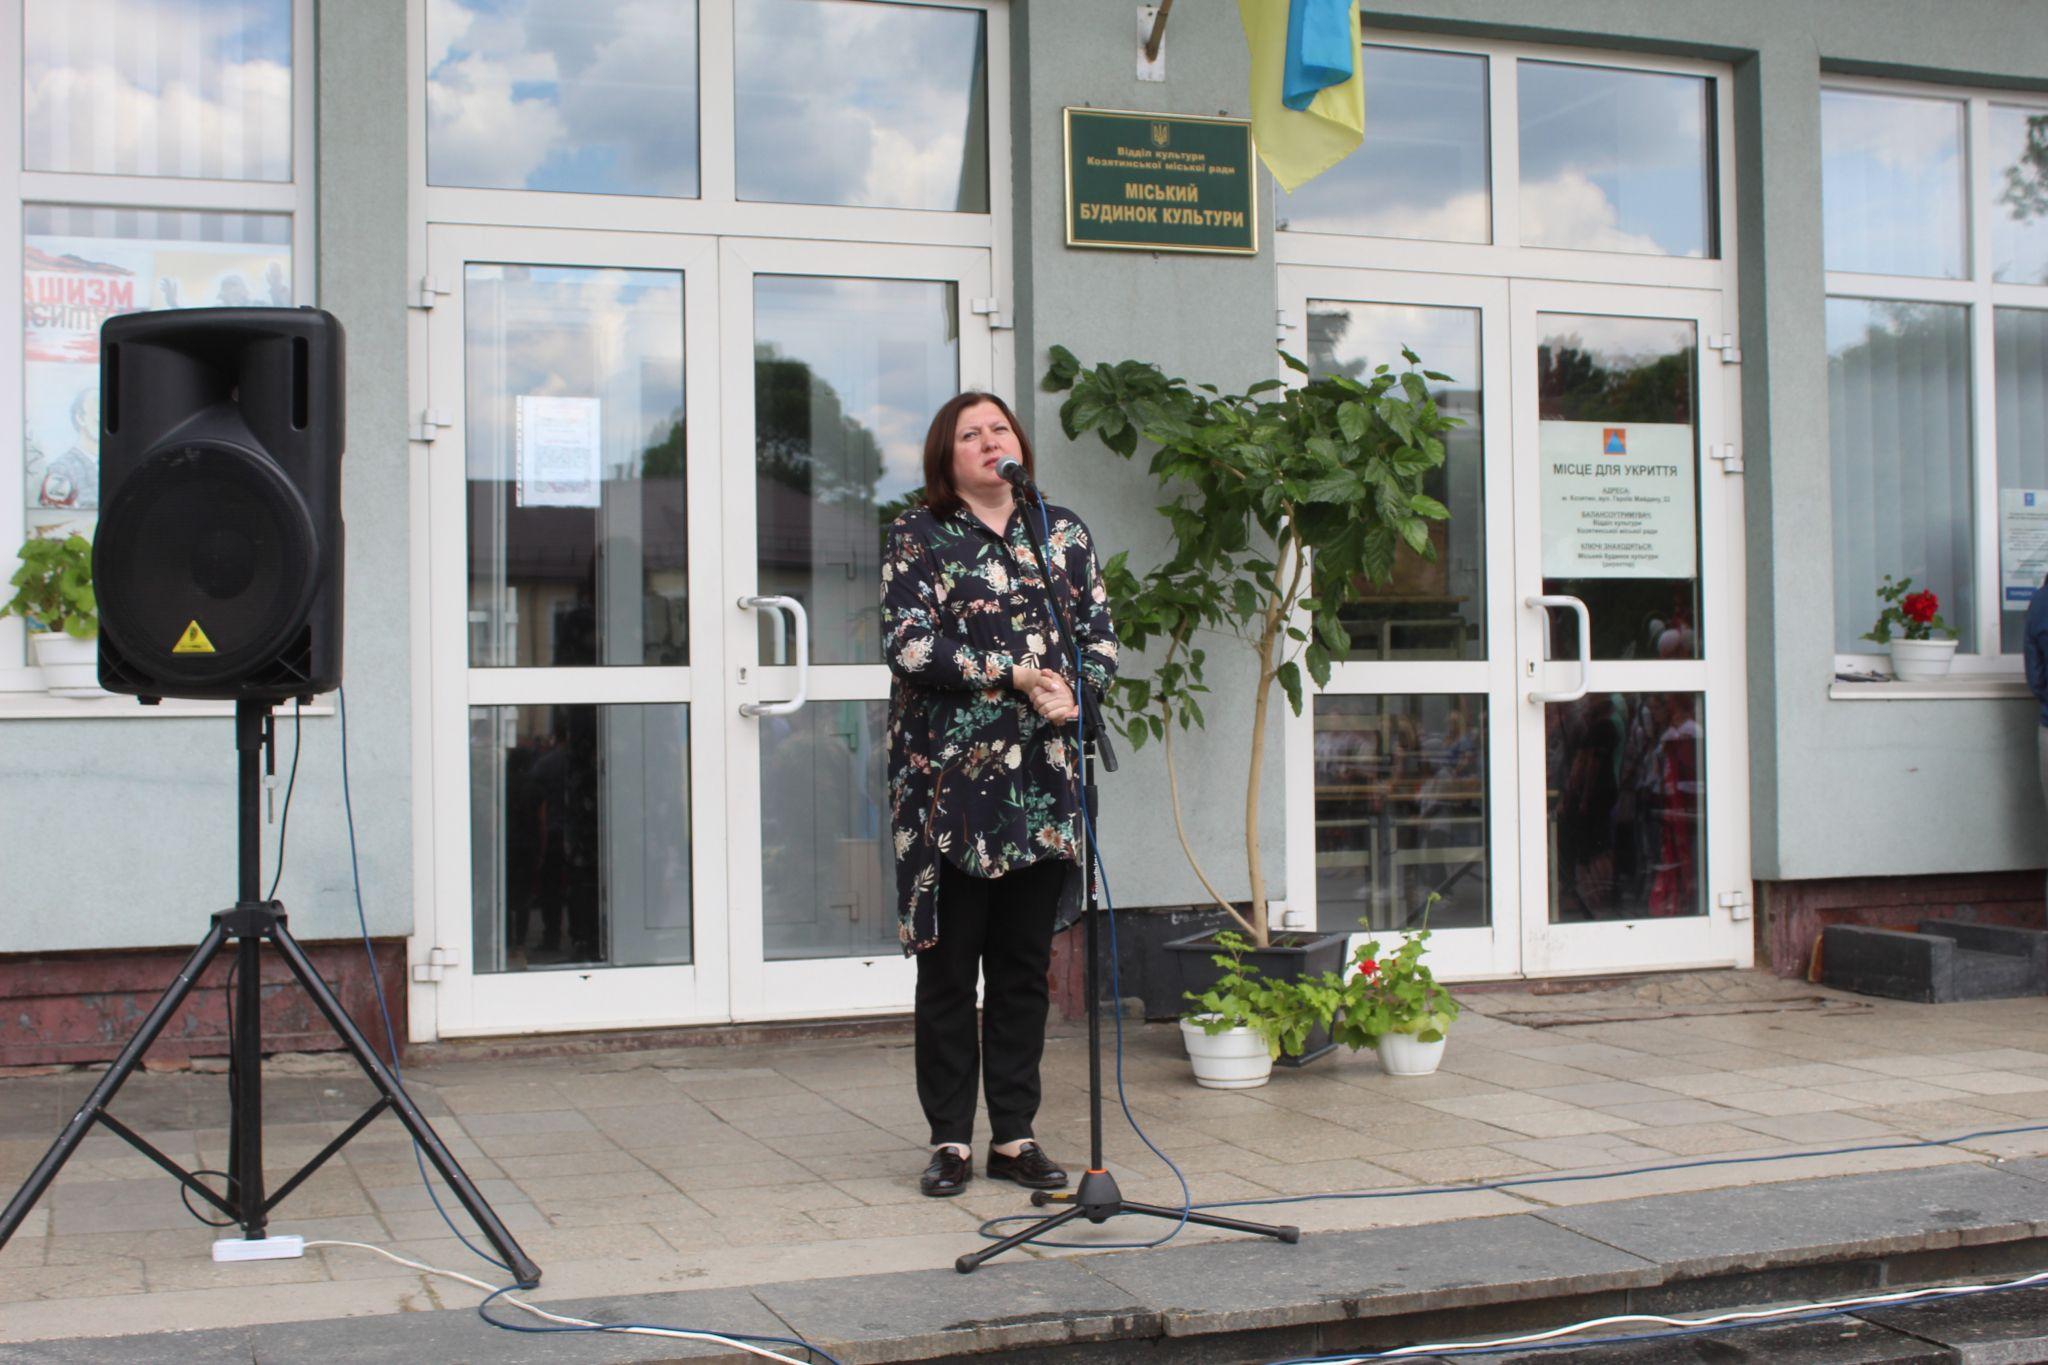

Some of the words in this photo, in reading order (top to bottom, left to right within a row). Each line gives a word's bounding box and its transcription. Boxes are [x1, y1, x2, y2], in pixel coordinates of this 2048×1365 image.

[1117, 146, 1152, 158] Відділ
[1155, 150, 1205, 161] культури
[1087, 156, 1161, 169] Козятинської
[1165, 160, 1205, 172] міської
[1209, 165, 1235, 175] ради
[1125, 183, 1198, 202] МІСЬКИЙ
[1080, 203, 1158, 223] БУДИНОК
[1162, 207, 1244, 228] КУЛЬТУРИ
[1553, 463, 1592, 476] МІСЦЕ
[1595, 464, 1621, 477] ДЛЯ
[1625, 465, 1678, 477] УКРИТТЯ
